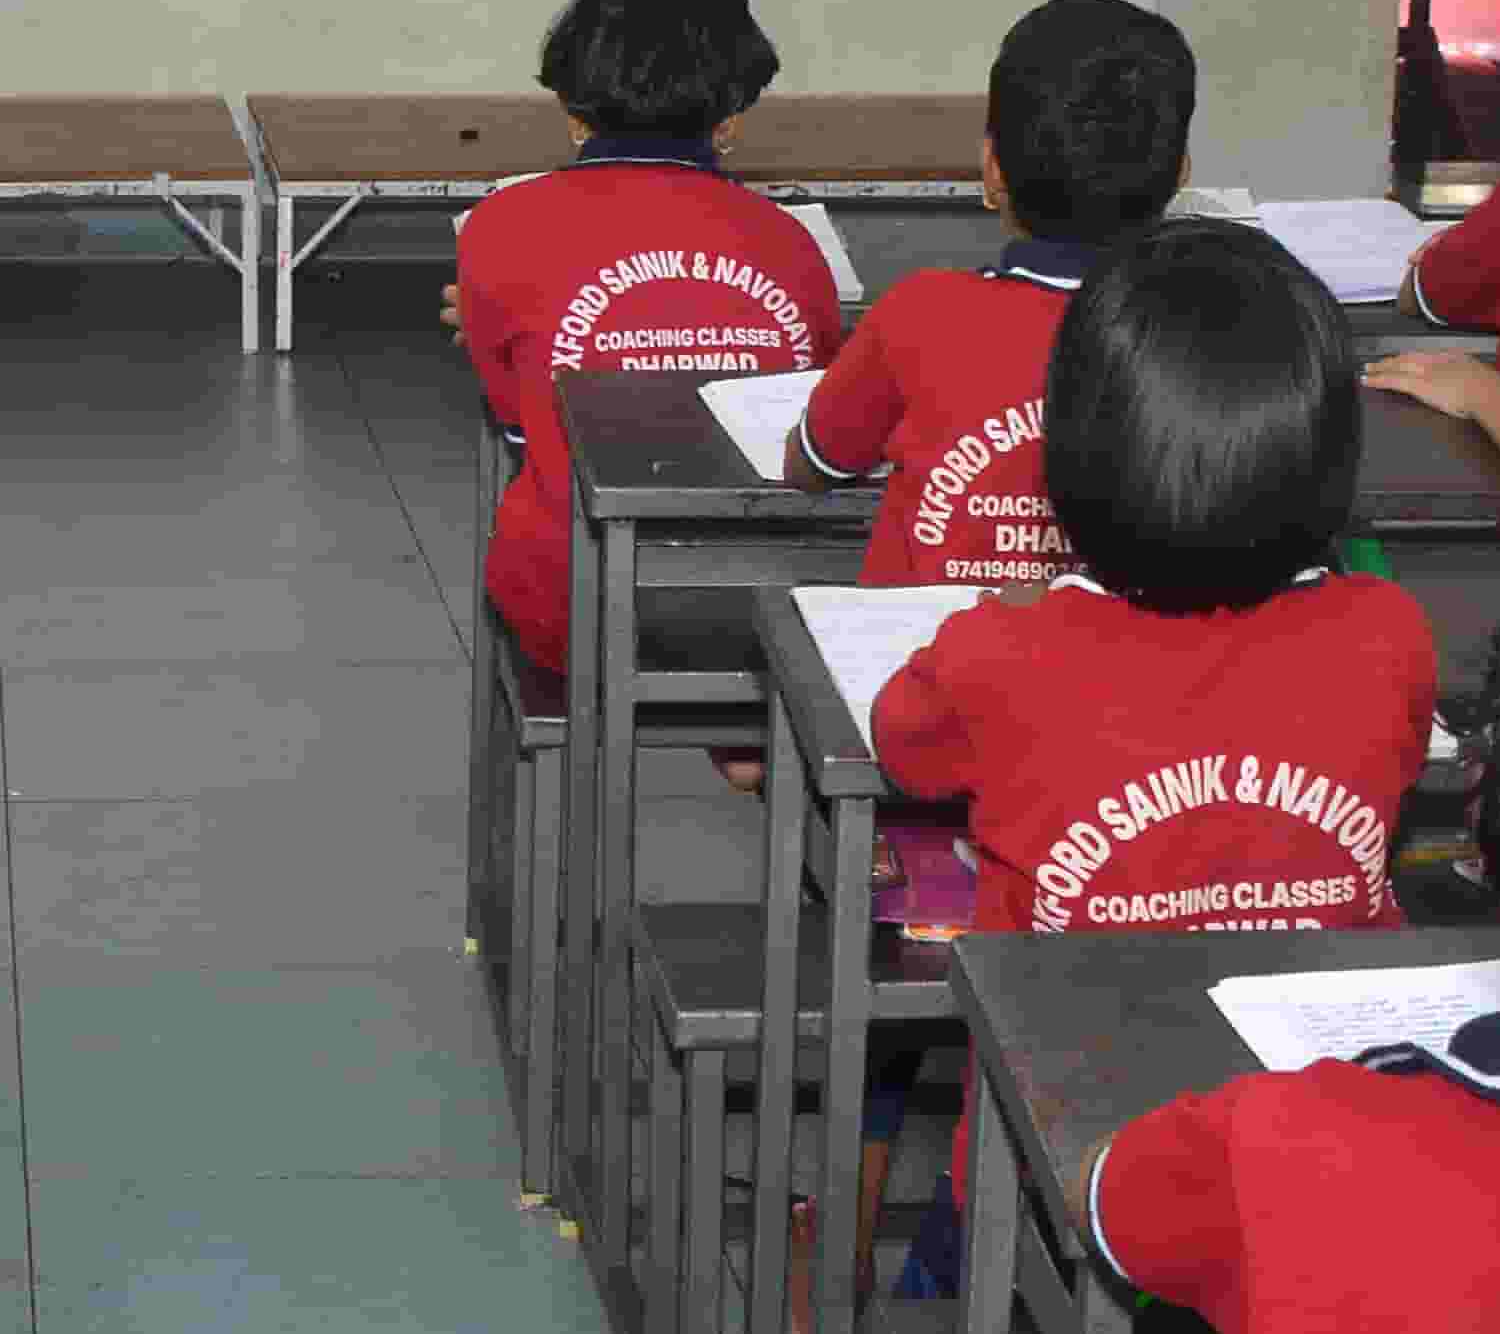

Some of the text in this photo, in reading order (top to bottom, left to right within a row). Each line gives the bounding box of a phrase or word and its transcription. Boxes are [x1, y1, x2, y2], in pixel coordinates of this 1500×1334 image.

[599, 250, 688, 294] SAINIK
[691, 252, 709, 281] &
[595, 325, 781, 352] COACHING CLASSES
[914, 435, 991, 546] OXFORD
[1098, 755, 1228, 841] SAINIK
[1235, 755, 1262, 803] &
[1088, 875, 1356, 923] COACHING CLASSES
